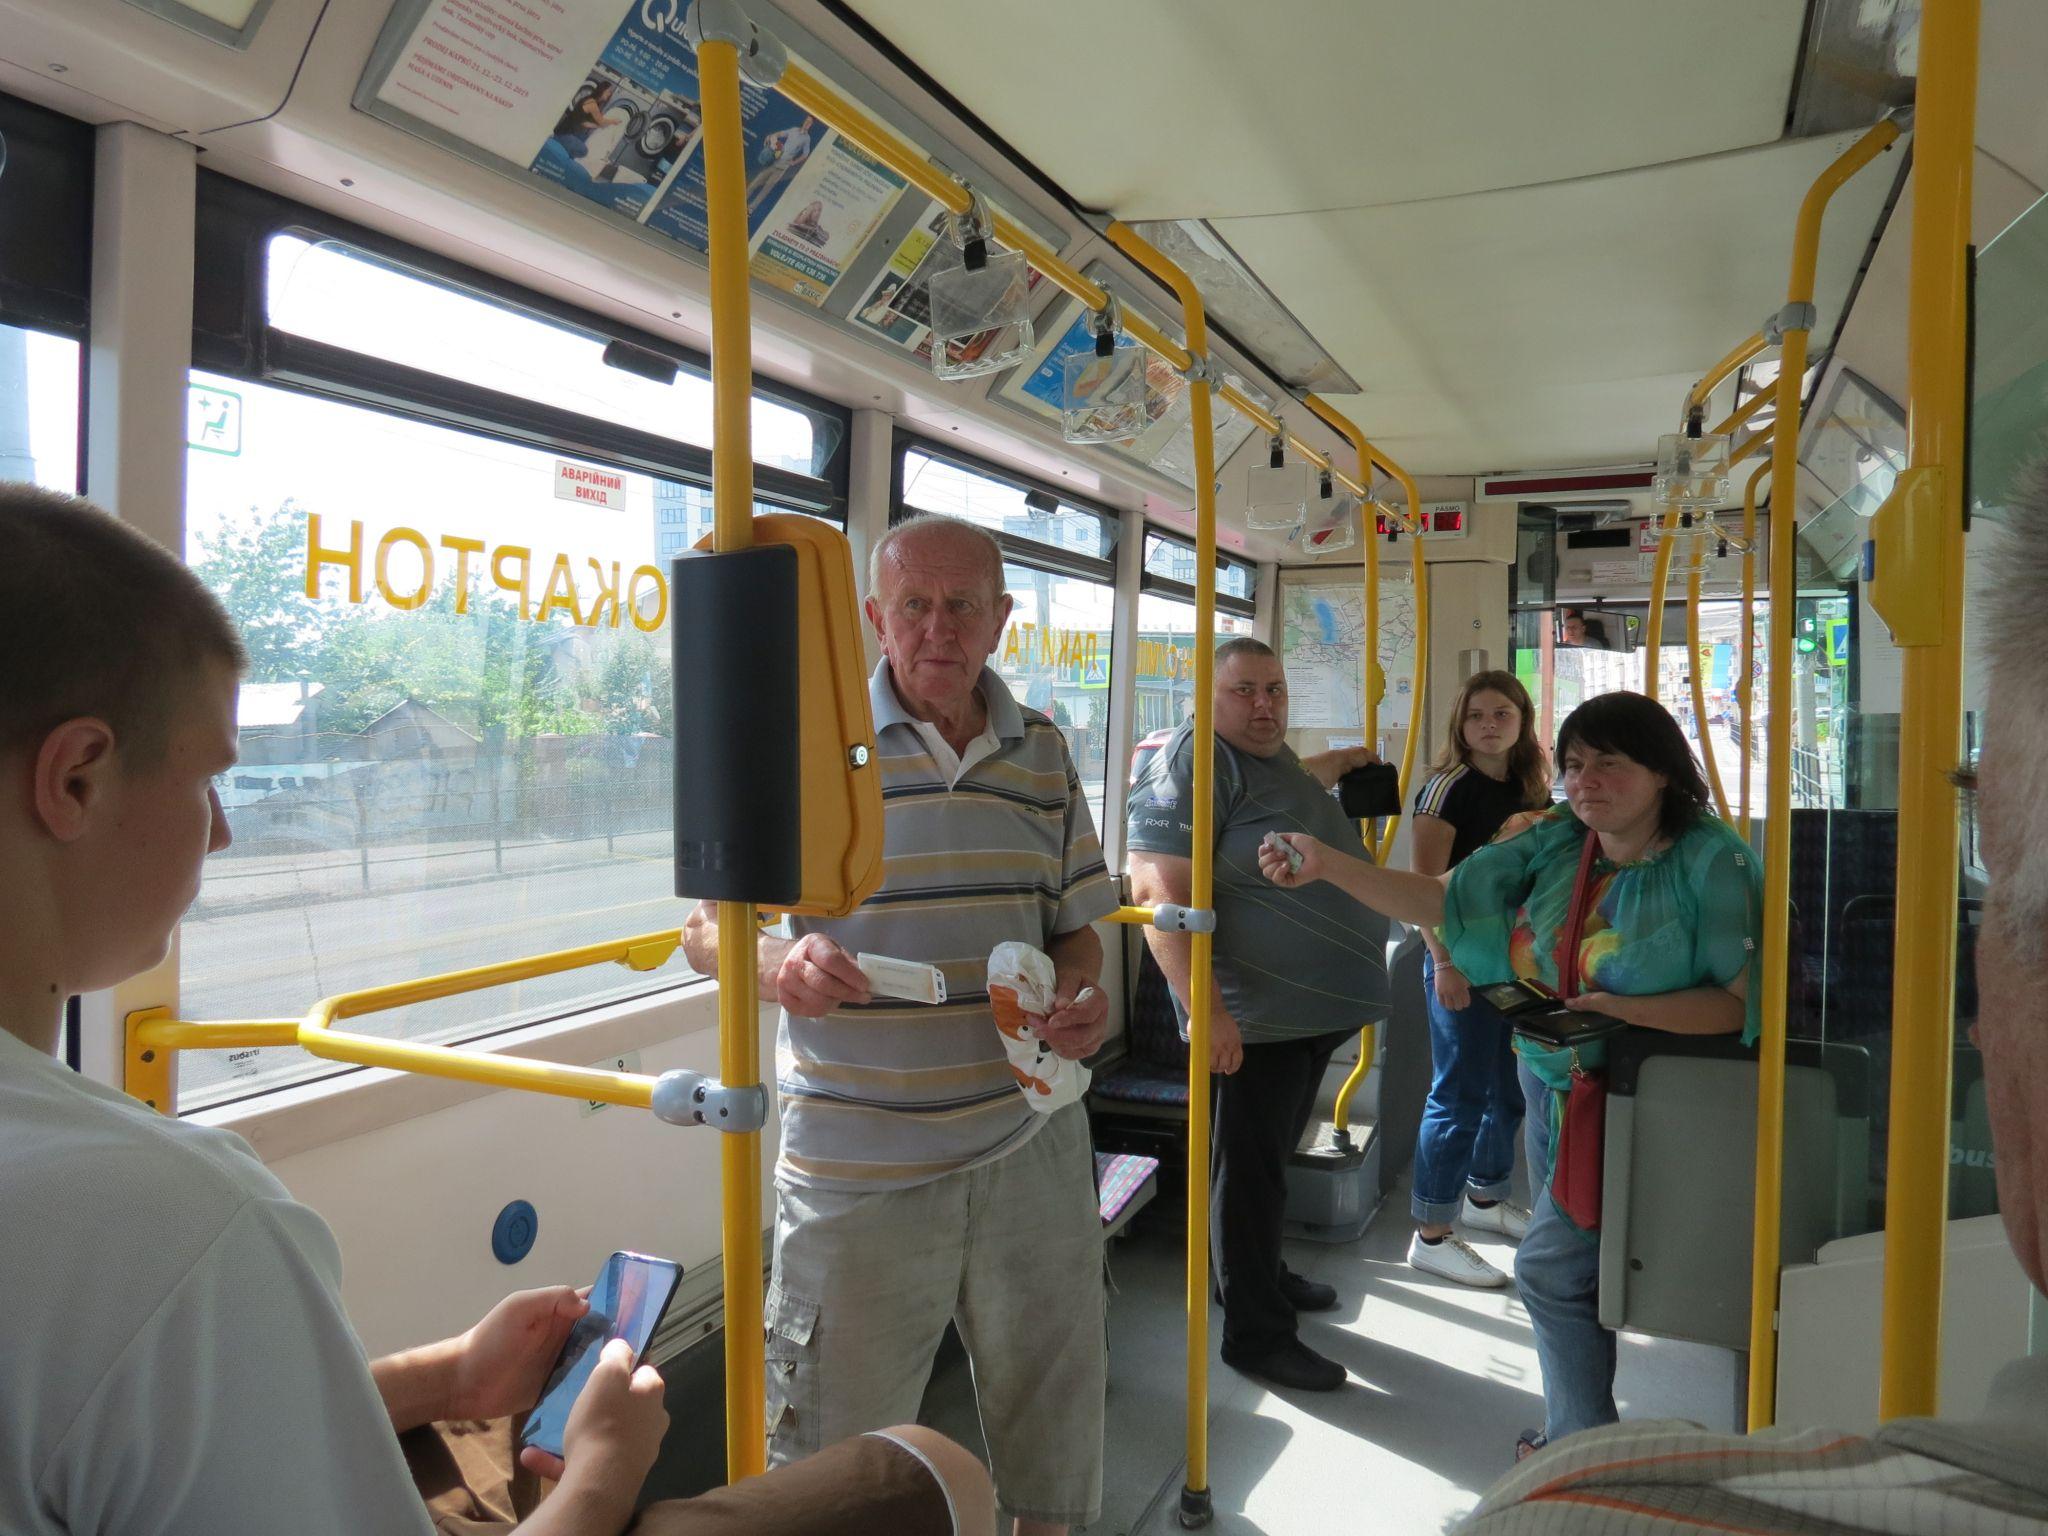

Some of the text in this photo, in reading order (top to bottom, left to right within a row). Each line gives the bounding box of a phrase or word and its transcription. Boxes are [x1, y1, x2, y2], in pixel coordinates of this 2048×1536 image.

[422, 35, 448, 53] PRODEJ
[770, 249, 795, 265] VOLEJTE
[561, 466, 621, 490] АВАРІЙНИЙ
[575, 486, 607, 505] ВИХІД
[1145, 818, 1169, 828] RXR
